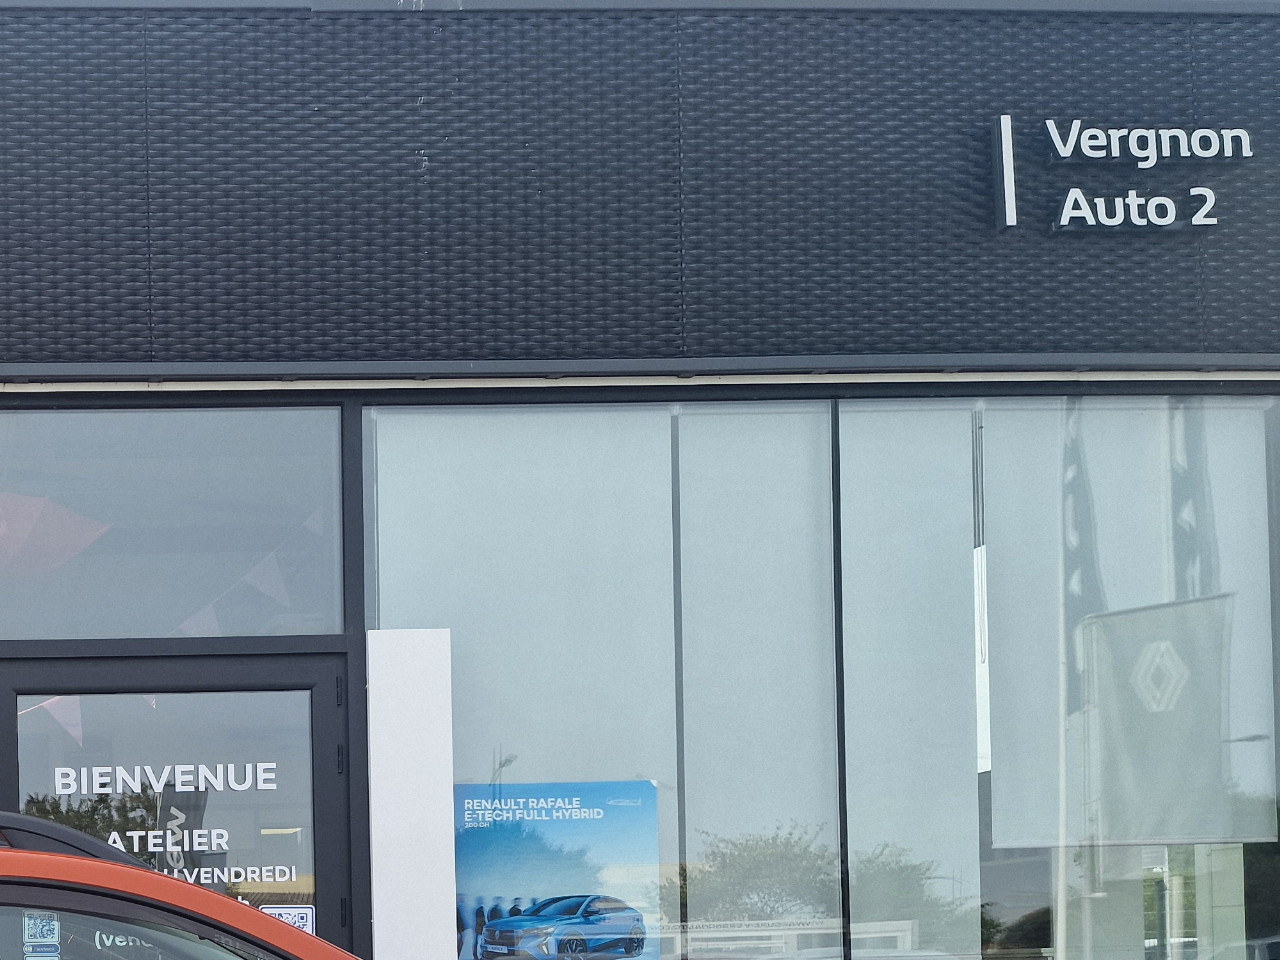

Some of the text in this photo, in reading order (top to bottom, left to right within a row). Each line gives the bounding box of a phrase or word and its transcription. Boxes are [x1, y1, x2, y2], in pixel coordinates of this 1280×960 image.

[1045, 119, 1253, 169] Vergnon
[1060, 187, 1218, 227] Auto 2
[54, 762, 277, 795] BIENVENUE
[464, 797, 581, 810] RENAULT RAFALE
[464, 808, 604, 821] E-TECH FULL HYBRID
[107, 829, 229, 853] ATELIER
[183, 866, 296, 884] VENDREDI
